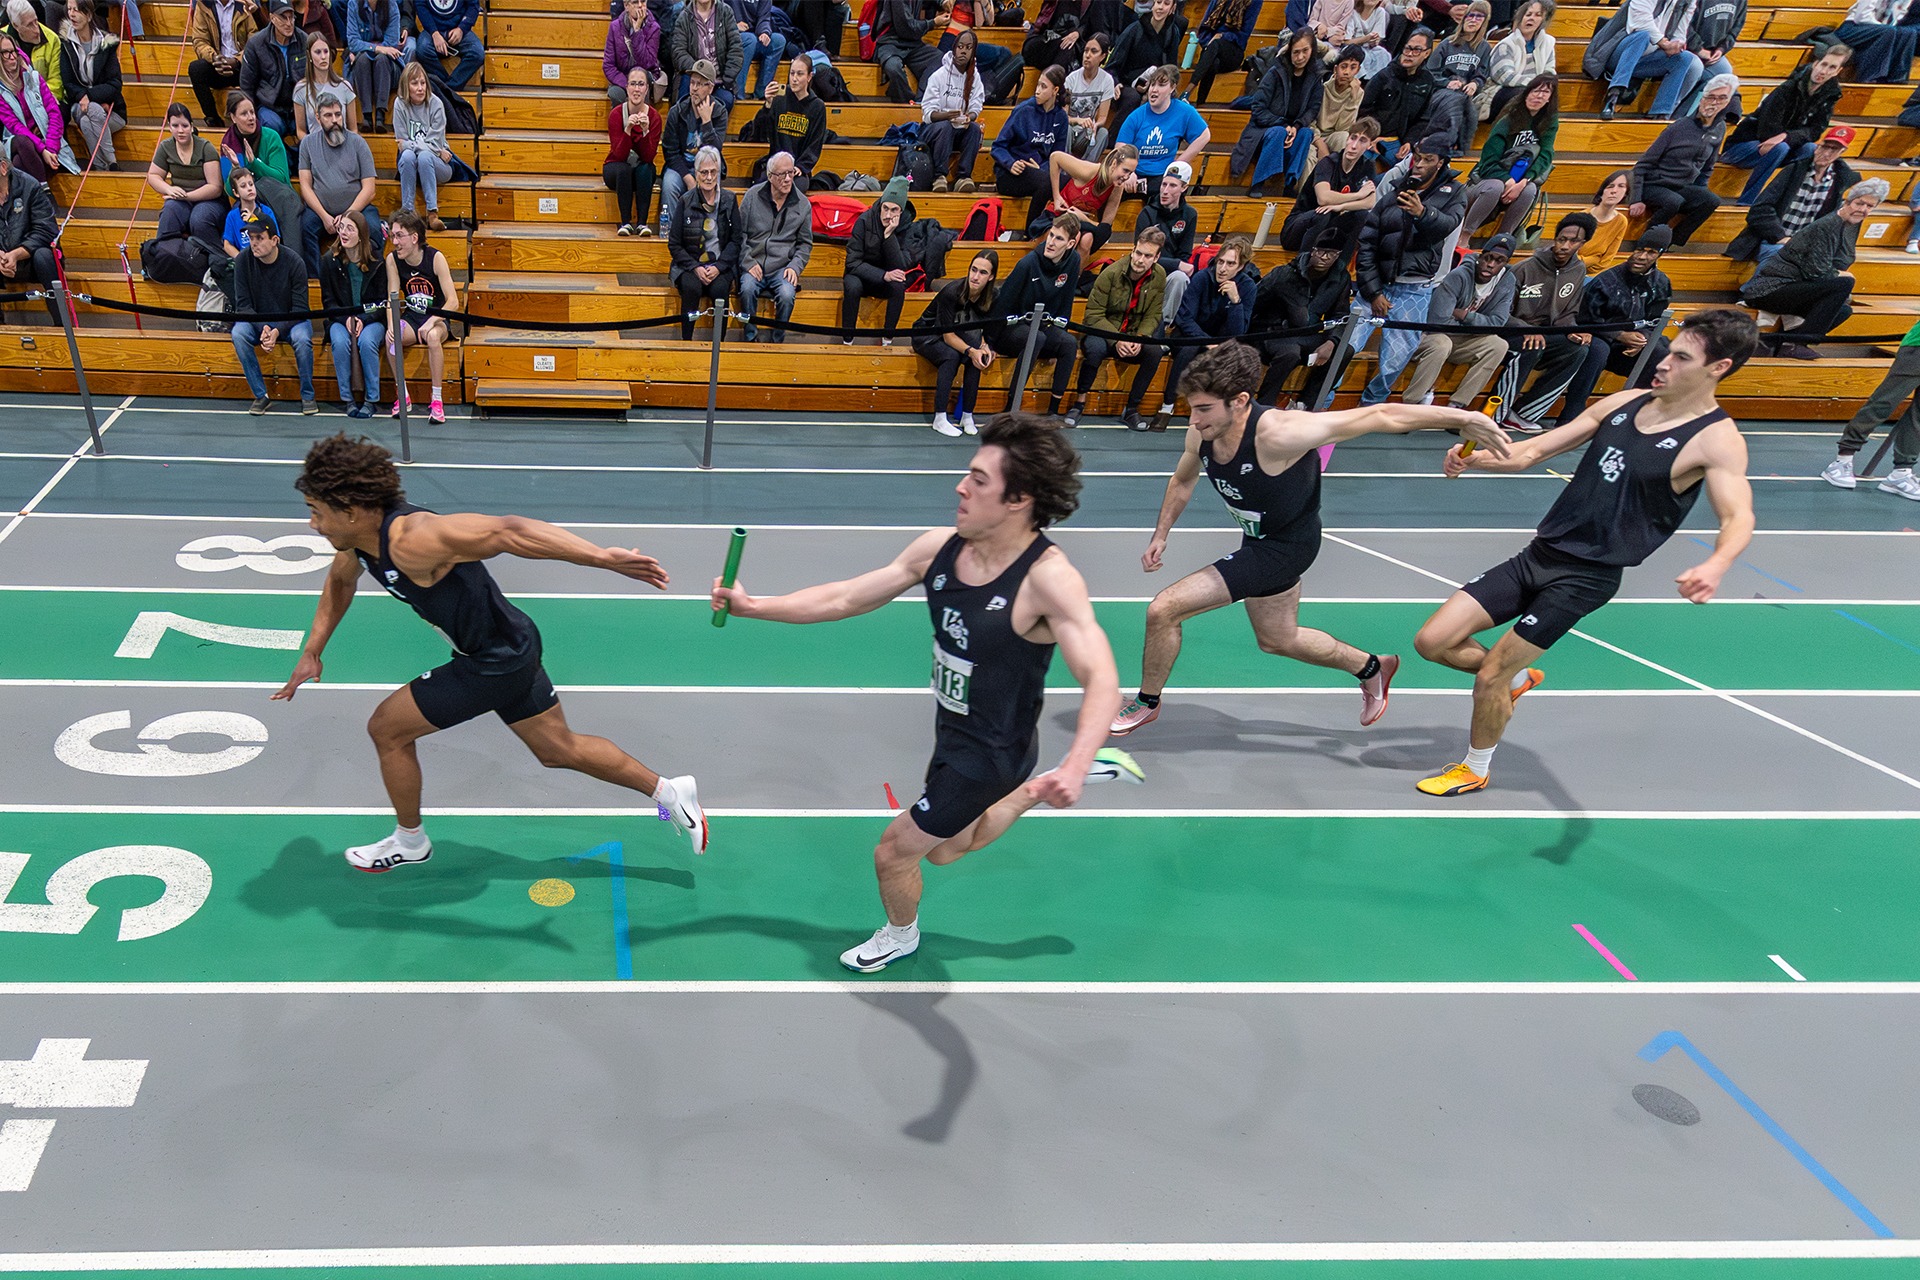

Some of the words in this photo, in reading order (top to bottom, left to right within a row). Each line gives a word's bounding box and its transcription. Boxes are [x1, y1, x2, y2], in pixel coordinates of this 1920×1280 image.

[175, 535, 335, 576] 8
[114, 611, 305, 659] 7
[54, 709, 269, 777] 6
[0, 844, 213, 942] 5
